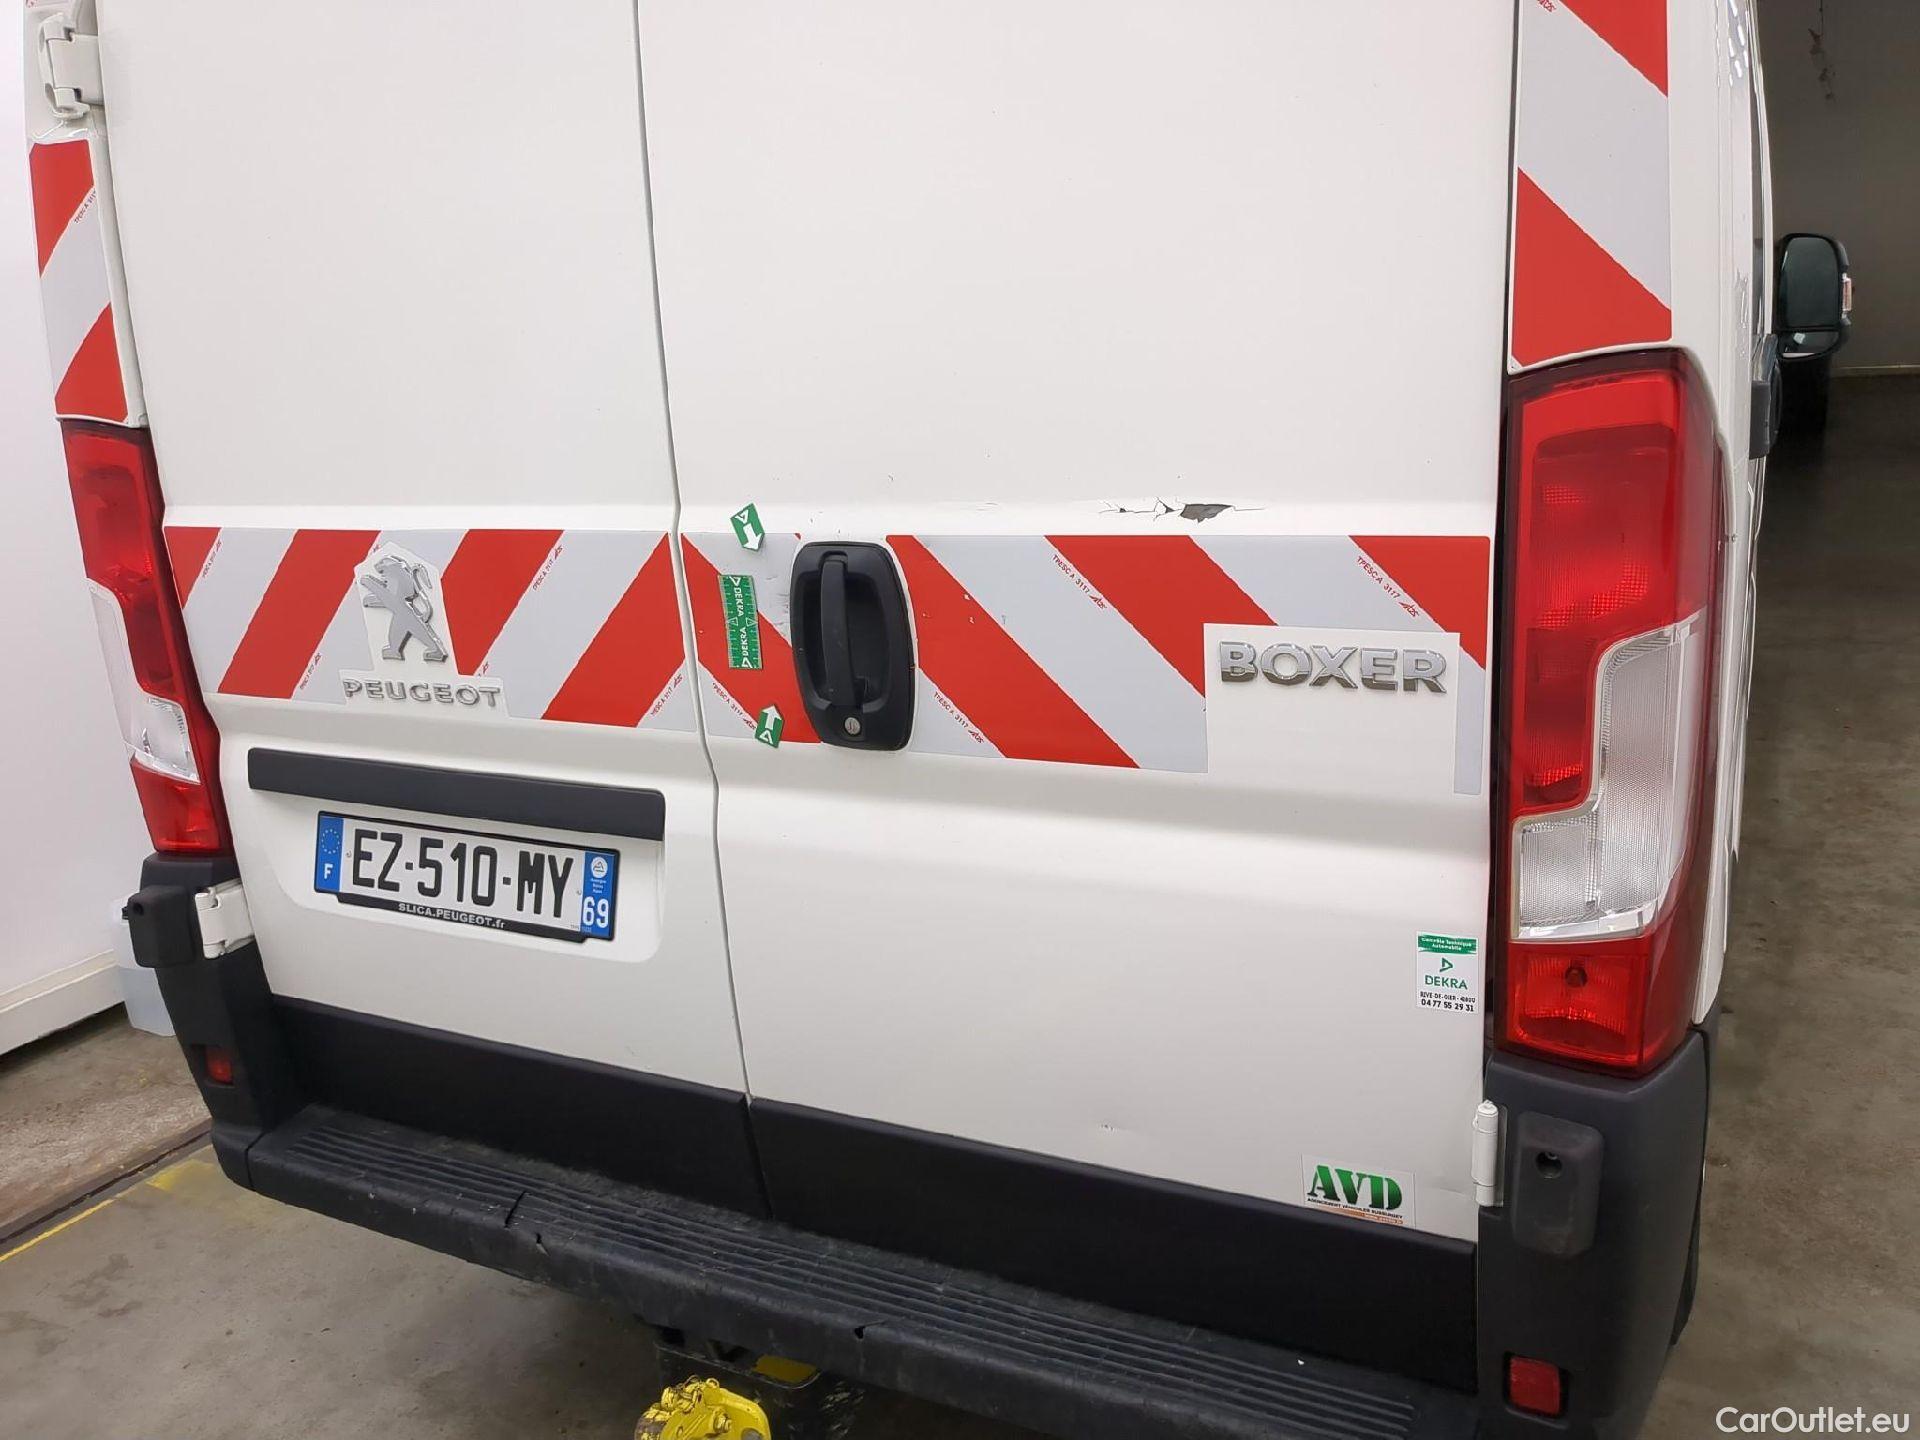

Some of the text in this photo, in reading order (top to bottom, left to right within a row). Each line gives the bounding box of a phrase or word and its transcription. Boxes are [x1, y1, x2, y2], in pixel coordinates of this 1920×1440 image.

[733, 586, 745, 617] DEKRA
[740, 626, 749, 656] DEKRA
[1219, 641, 1447, 694] BOXER
[343, 678, 501, 708] PEUGEOT
[324, 863, 334, 880] F
[353, 828, 574, 918] EZ-510-MY
[399, 903, 506, 930] SLICA.PEUGEOT.fr
[583, 896, 610, 929] 69
[1424, 975, 1468, 990] DEKRA
[1307, 1164, 1403, 1211] AVD
